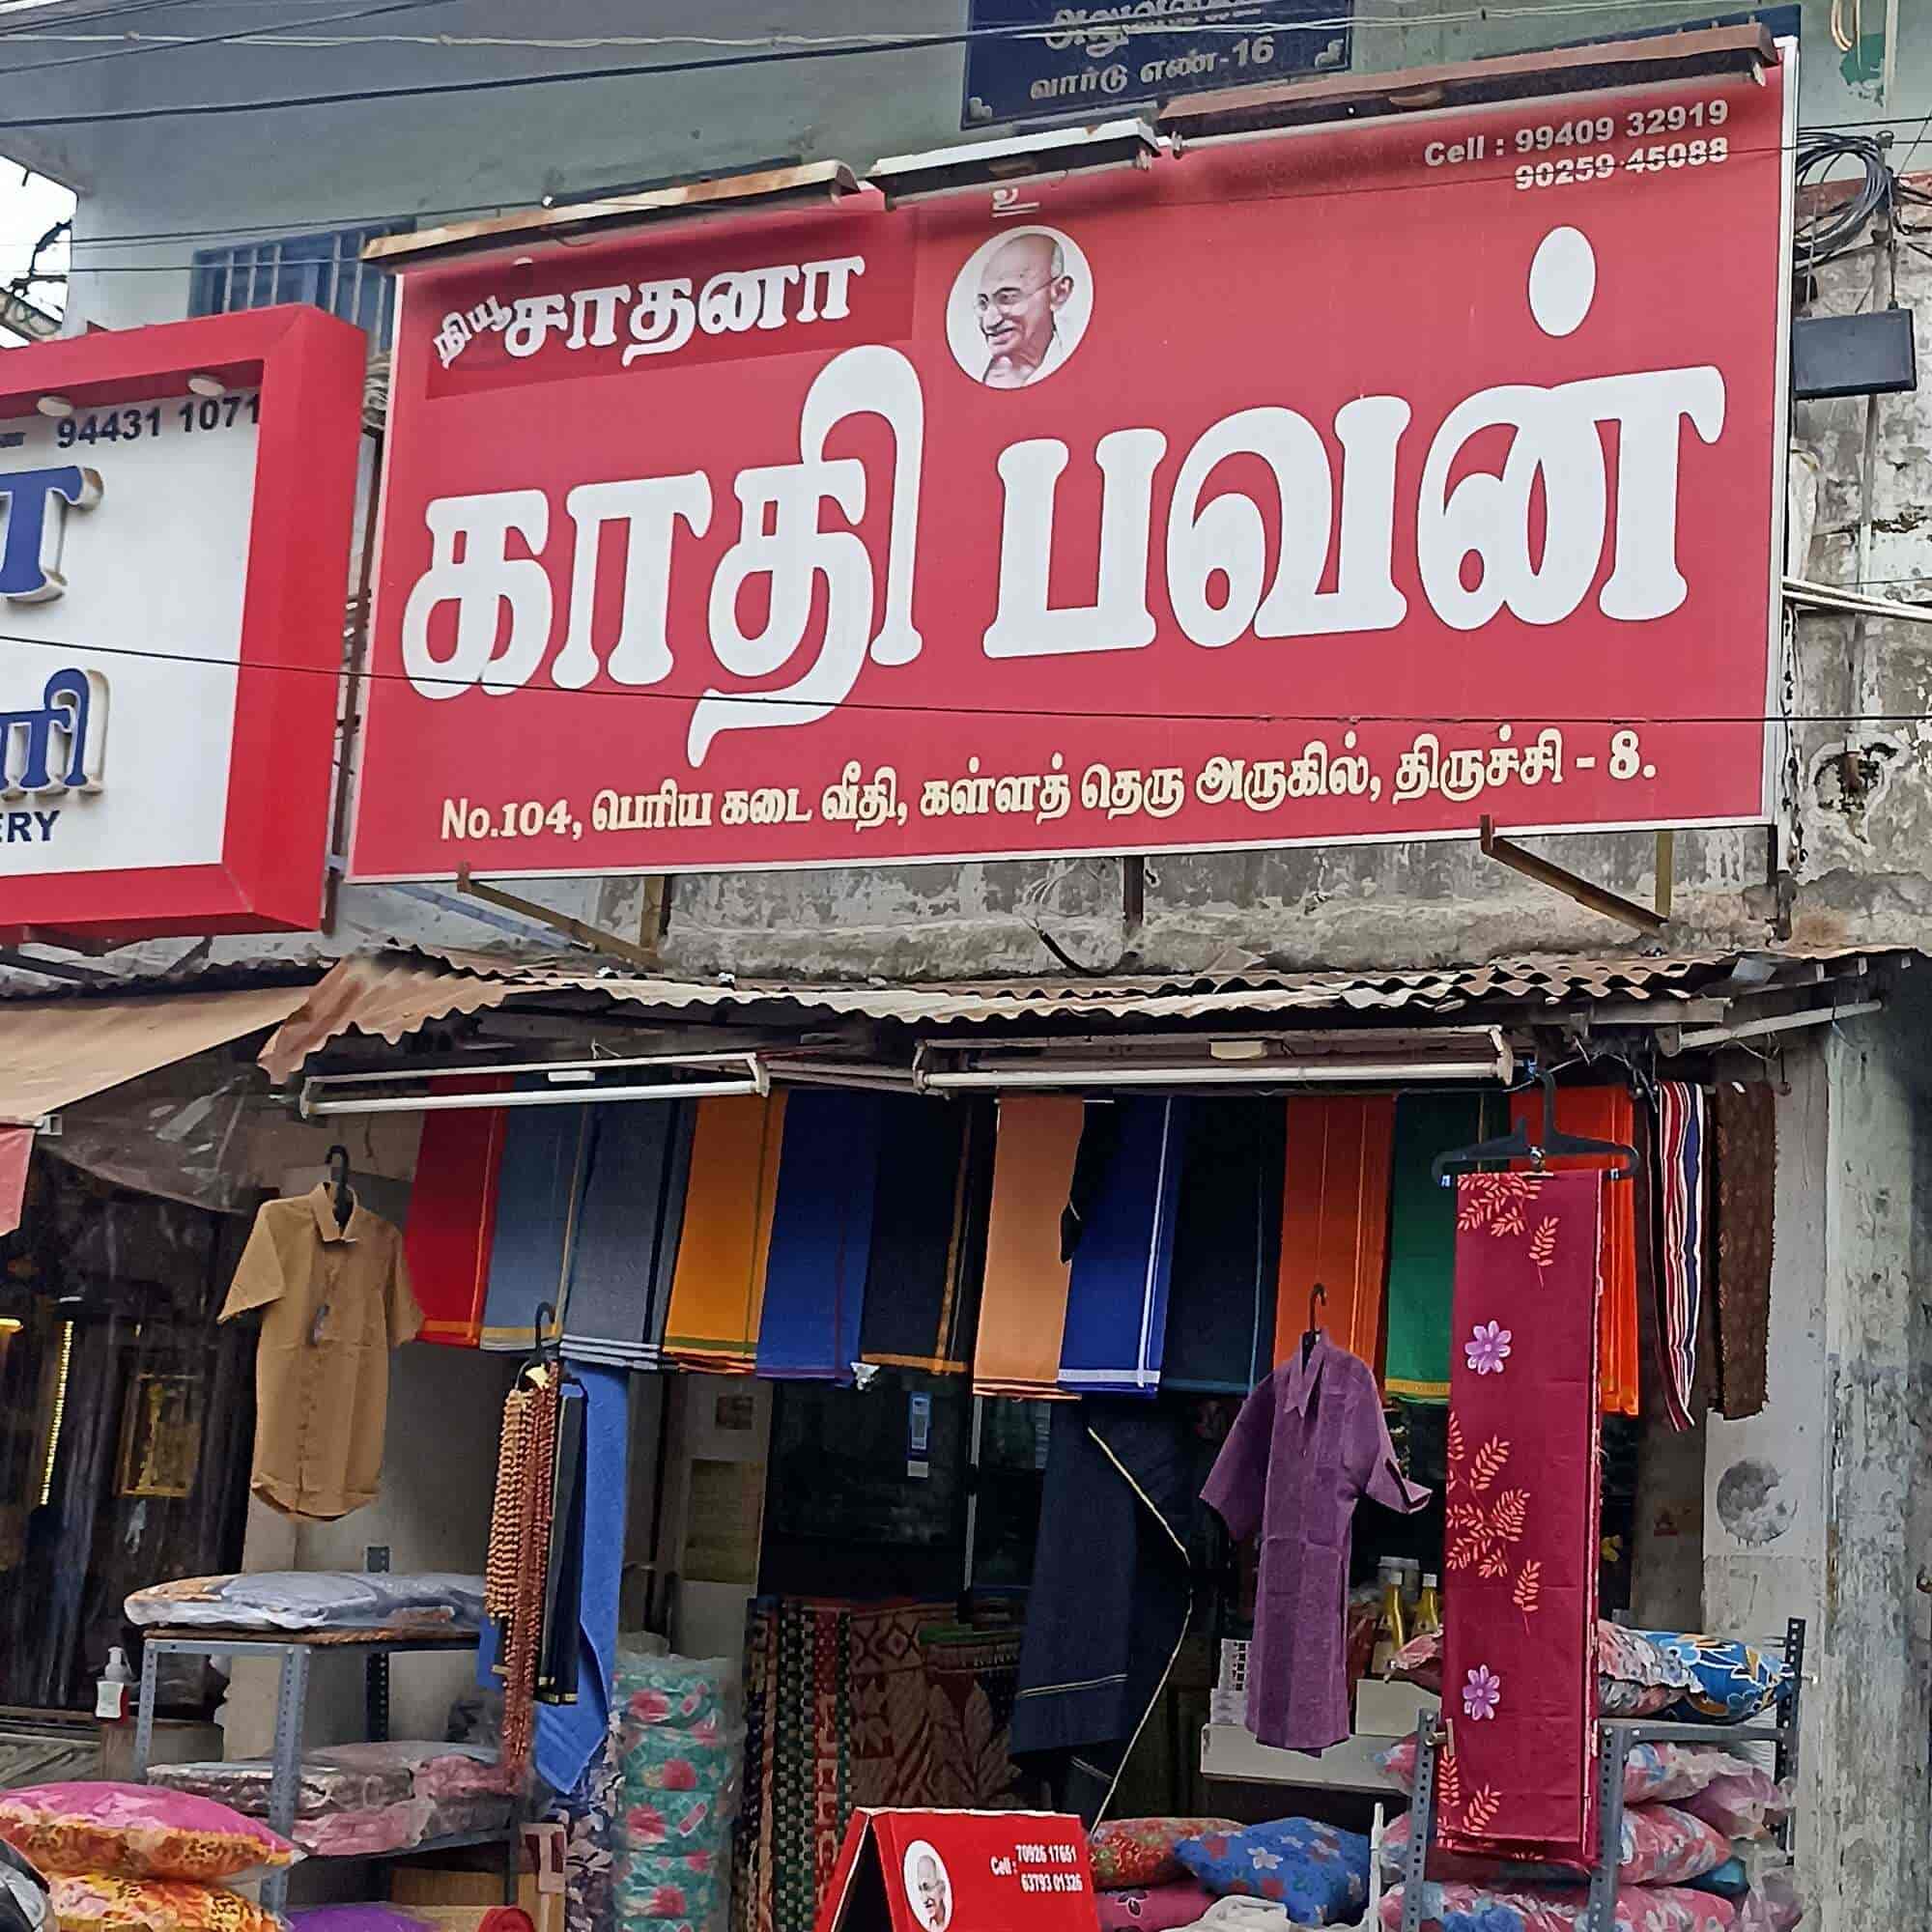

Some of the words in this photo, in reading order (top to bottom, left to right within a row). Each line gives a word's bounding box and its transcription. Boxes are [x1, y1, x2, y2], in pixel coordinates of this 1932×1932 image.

[1030, 64, 1127, 99] வார்டு
[1425, 136, 1485, 166] Cell
[1515, 117, 1614, 153] 99409
[1626, 99, 1728, 137] 32919
[1515, 153, 1615, 189] 90259
[1625, 137, 1728, 174] 45088
[433, 295, 513, 369] நியூ
[504, 255, 866, 367] சாதனா
[57, 407, 161, 448] 94431
[402, 344, 924, 766] காதி
[982, 226, 1725, 659] பவன்
[441, 798, 582, 840] No.104,
[592, 778, 714, 832] பெரிய
[721, 787, 812, 825] கடை
[821, 760, 908, 833] வீதி,
[920, 753, 1071, 824] கள்ளத்
[1081, 763, 1185, 820] தெரு
[1195, 731, 1381, 811] அருகில்,
[1392, 724, 1563, 805] திருச்சி
